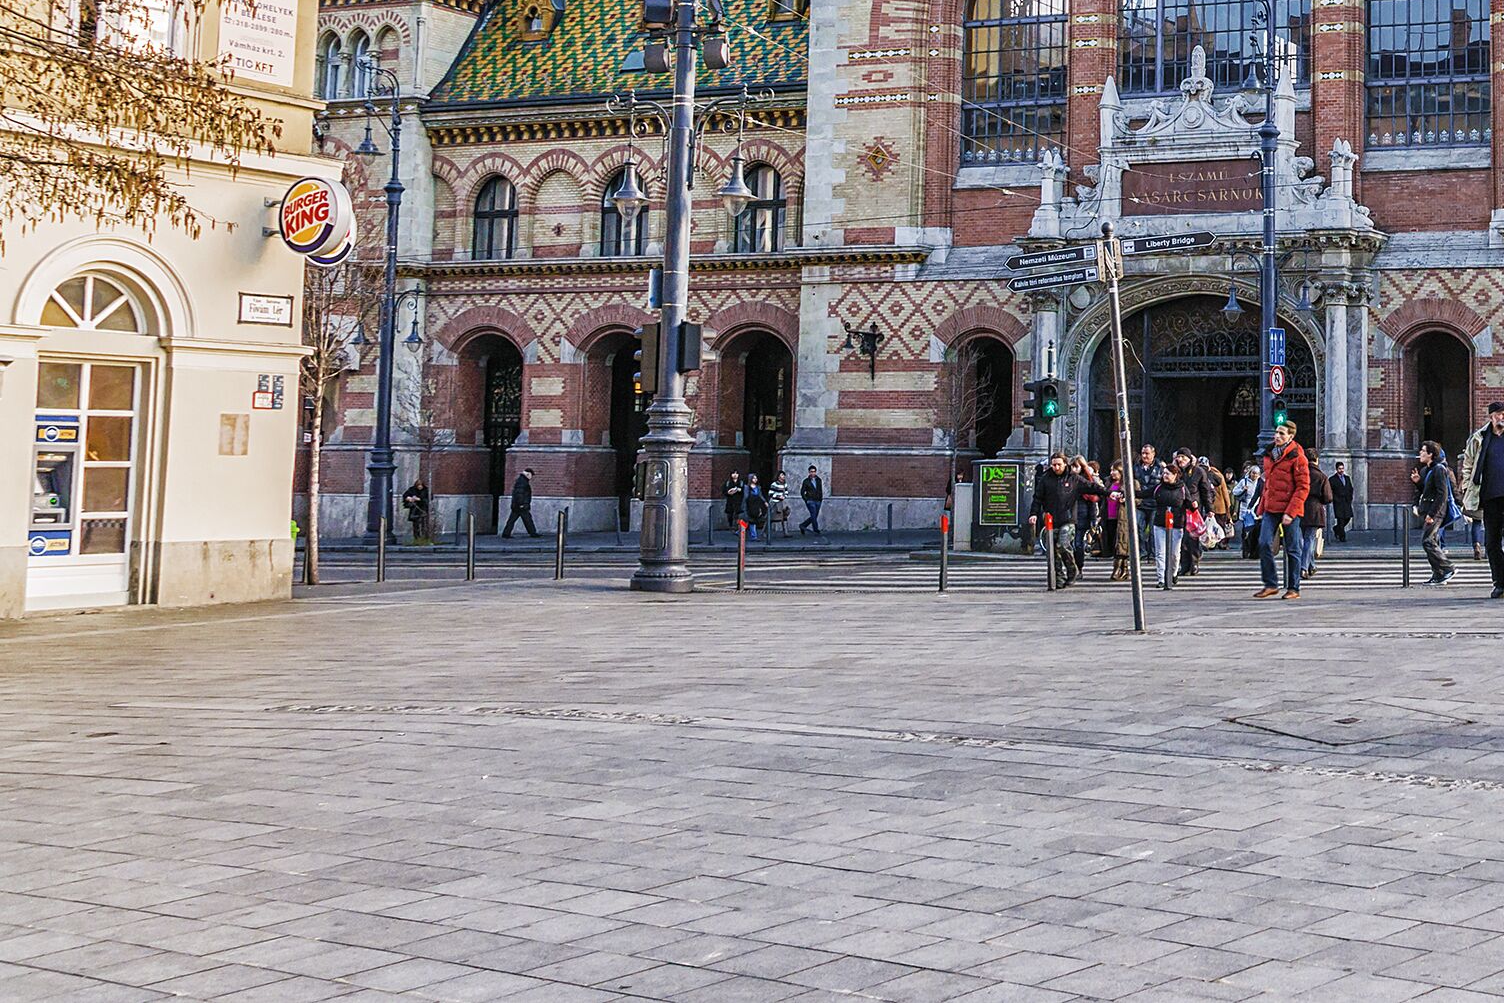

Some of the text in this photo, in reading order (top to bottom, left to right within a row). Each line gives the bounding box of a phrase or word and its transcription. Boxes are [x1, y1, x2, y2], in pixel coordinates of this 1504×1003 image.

[284, 190, 328, 220] BURGER
[285, 203, 329, 238] KING
[1146, 235, 1195, 248] Liberty Bridge
[1019, 252, 1077, 266] Nemzeti Múzeum
